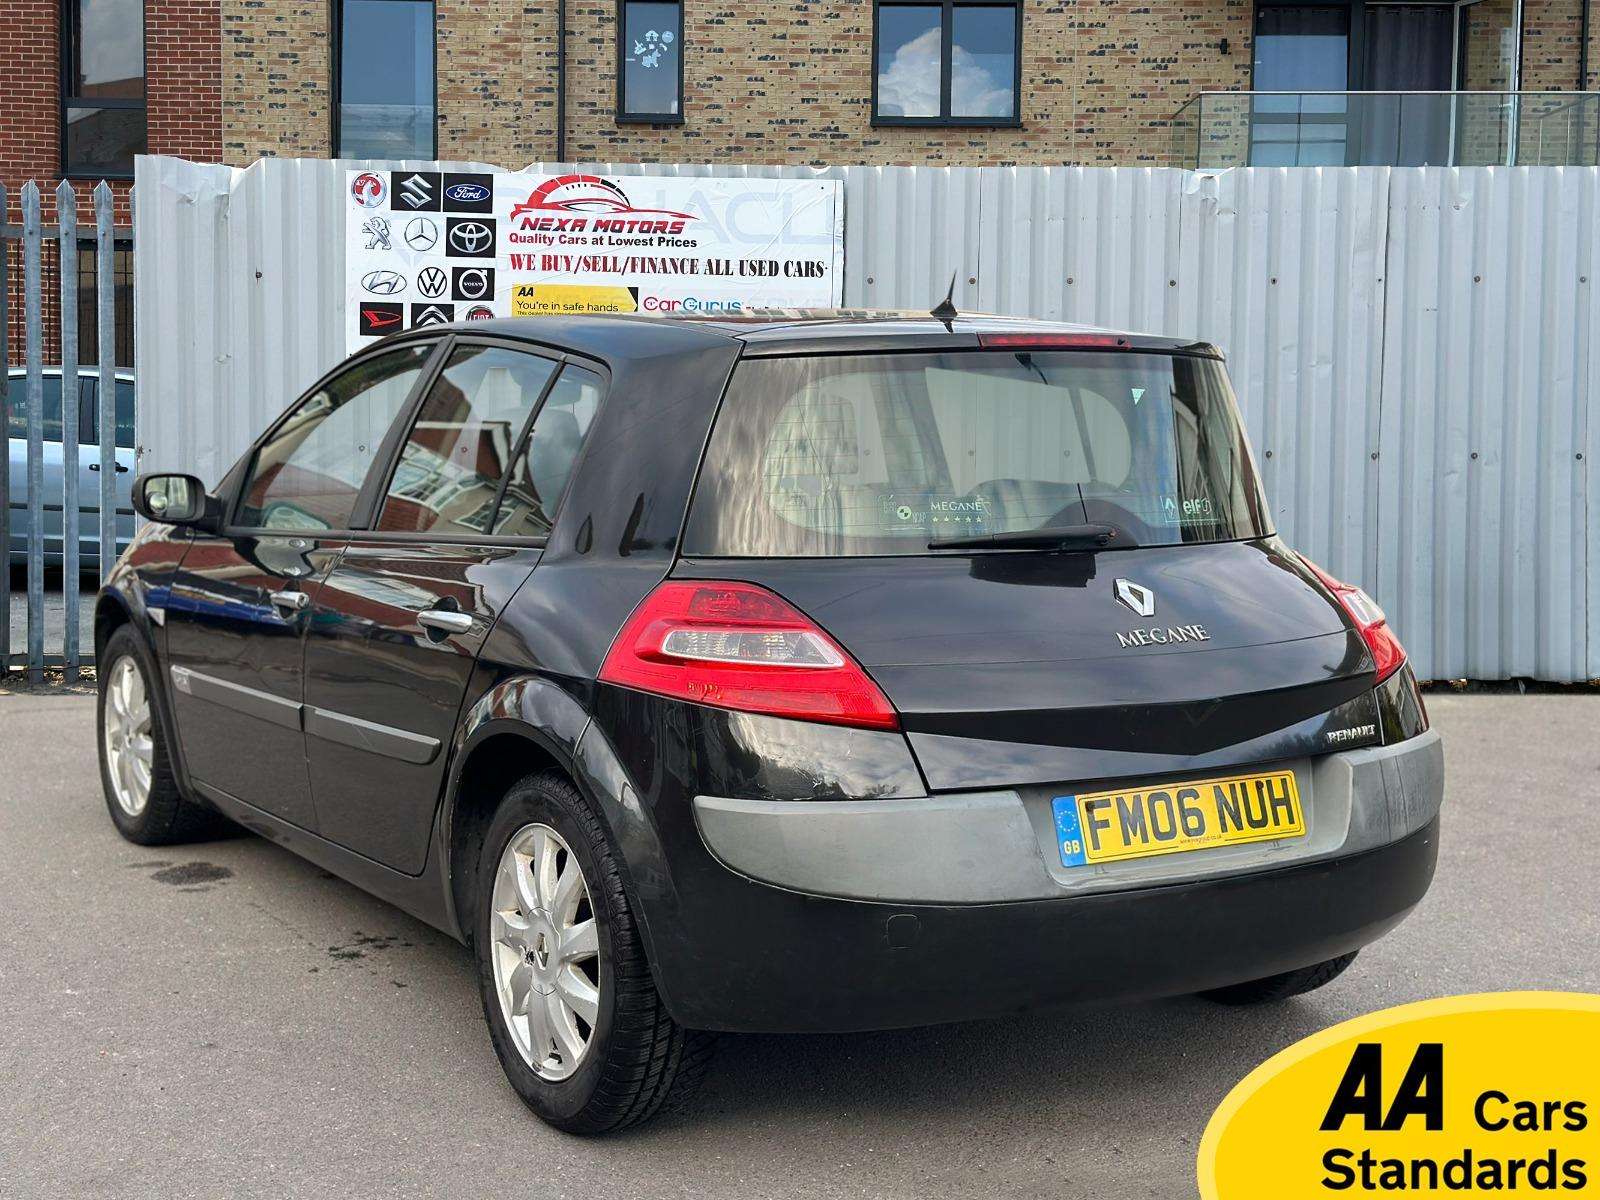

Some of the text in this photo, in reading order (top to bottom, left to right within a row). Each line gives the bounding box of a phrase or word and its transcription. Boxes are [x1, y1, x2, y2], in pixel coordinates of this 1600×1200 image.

[455, 187, 481, 198] Ford
[520, 217, 686, 235] NEXA MOTORS
[509, 232, 697, 248] Quality Cars at Lowest Prices
[509, 253, 825, 278] WE BUY/SELL/FINANCE ALL USED CARS
[517, 286, 534, 297] AA
[516, 300, 619, 312] You're in safe hands
[643, 296, 742, 311] CarGurus
[1116, 624, 1211, 648] MEGANE
[1086, 777, 1296, 851] FM06 NUH
[1064, 839, 1081, 855] GB
